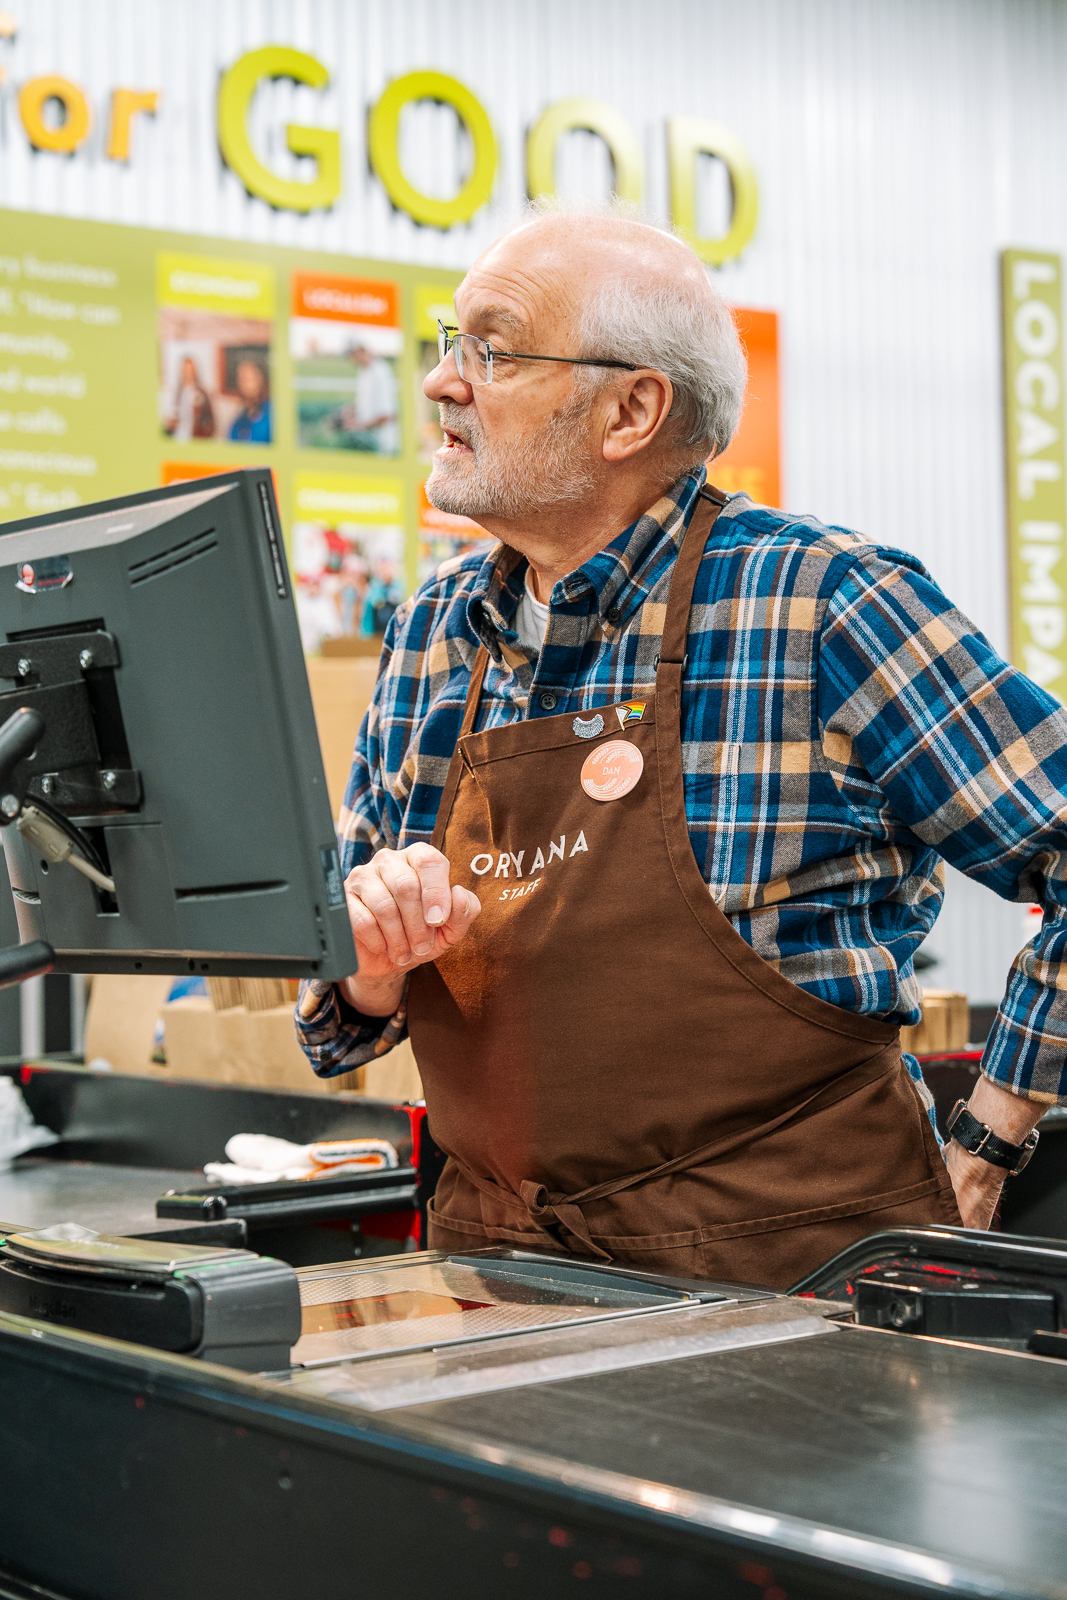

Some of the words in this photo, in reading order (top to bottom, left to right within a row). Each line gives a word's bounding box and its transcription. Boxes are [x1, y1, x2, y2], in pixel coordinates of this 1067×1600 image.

[217, 44, 759, 267] GOOD
[1012, 259, 1062, 500] LOCAL
[1018, 520, 1065, 706] IMPA
[602, 766, 621, 776] DAN
[470, 830, 589, 878] ORYANA
[499, 878, 541, 901] STAFF
